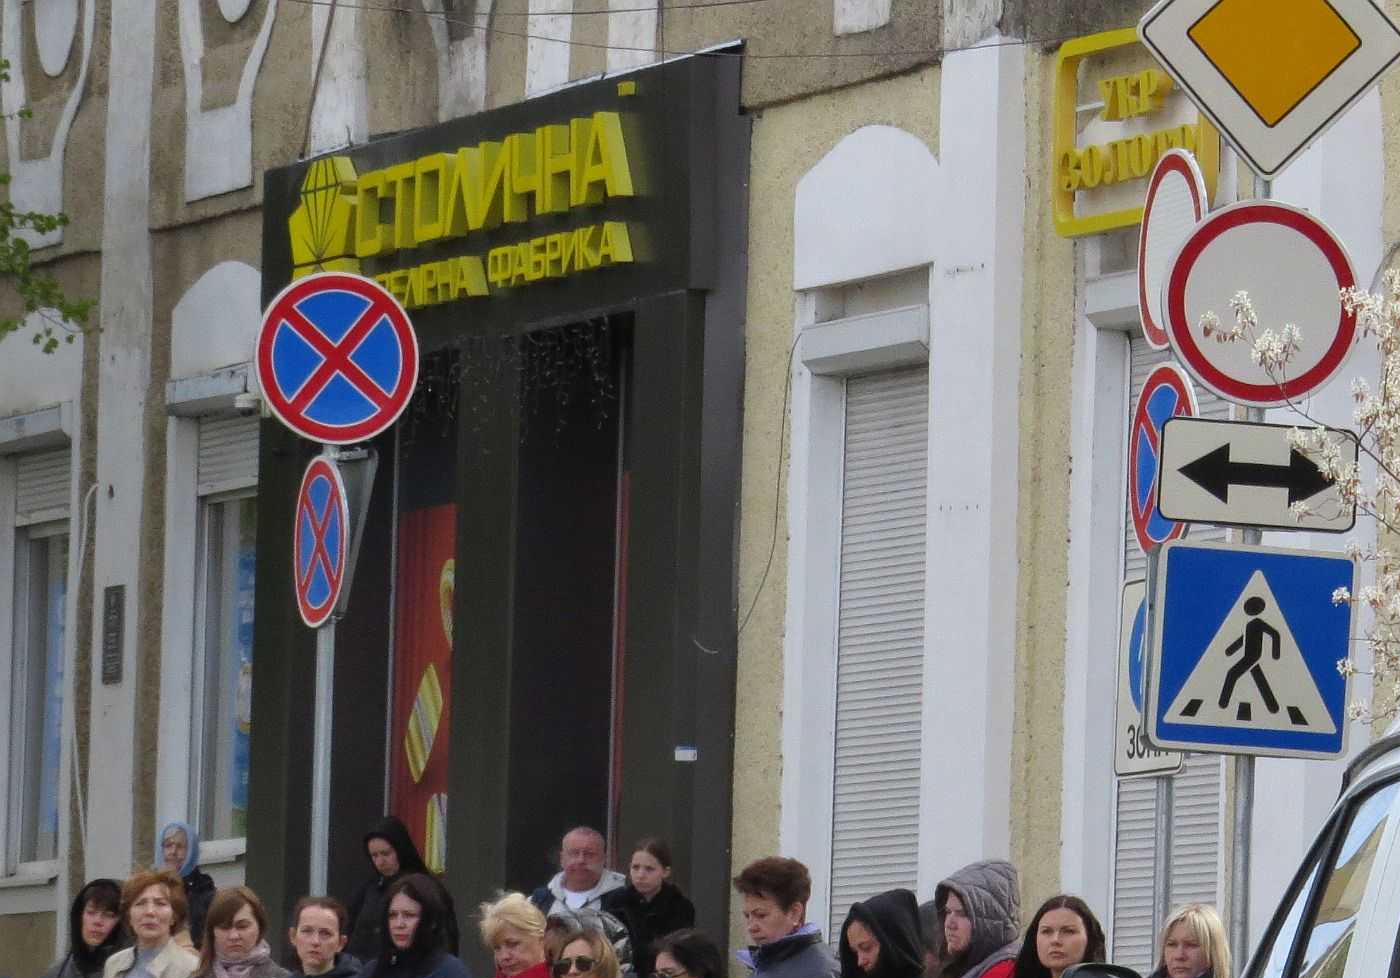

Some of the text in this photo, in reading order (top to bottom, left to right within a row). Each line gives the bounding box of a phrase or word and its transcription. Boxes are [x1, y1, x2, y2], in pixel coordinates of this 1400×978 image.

[1097, 68, 1173, 122] УКР
[355, 112, 634, 258] СТОЛИЧНА
[487, 221, 634, 288] ФАБРИКА
[1126, 724, 1169, 759] ЗО
